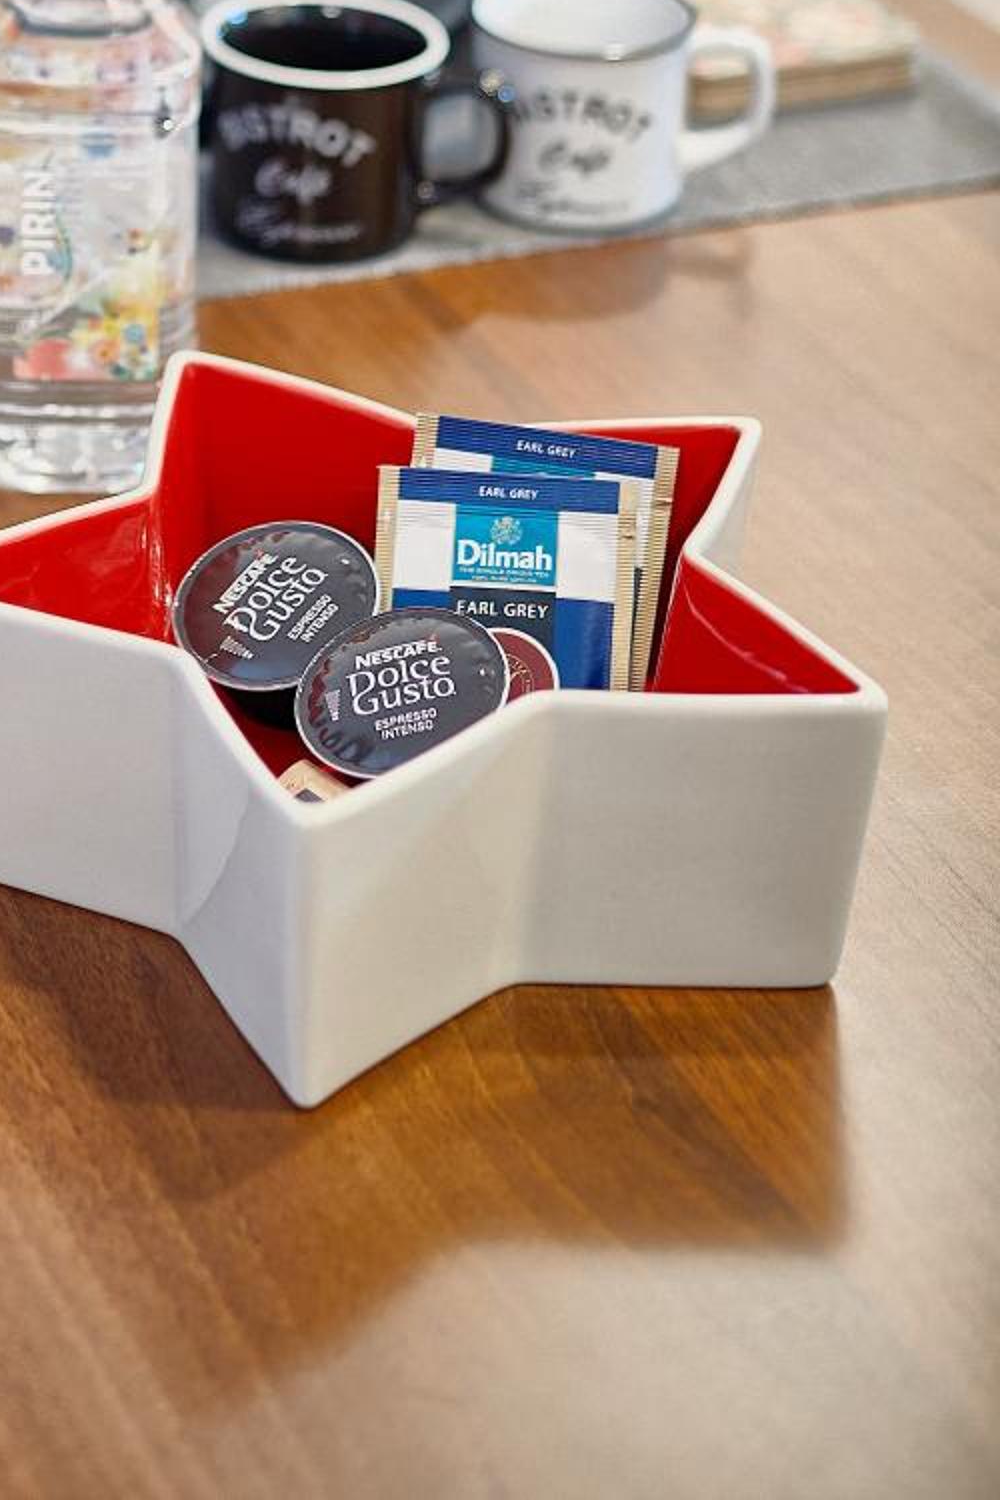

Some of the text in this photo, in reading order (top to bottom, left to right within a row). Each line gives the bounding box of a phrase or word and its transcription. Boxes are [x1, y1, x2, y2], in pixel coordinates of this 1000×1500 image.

[21, 168, 56, 276] PIRIN
[516, 440, 577, 459] EARL GREY
[479, 485, 539, 500] EARL GREY
[456, 538, 553, 572] Dilmah
[249, 568, 329, 641] Gusto
[286, 593, 332, 641] ESPRESSO
[299, 602, 339, 643] INTENSO
[455, 600, 549, 619] EARL GREY
[346, 655, 452, 698] Dolce
[351, 677, 457, 716] Gusto
[375, 707, 437, 732] ESPRESSO
[381, 719, 434, 741] INTENSO
